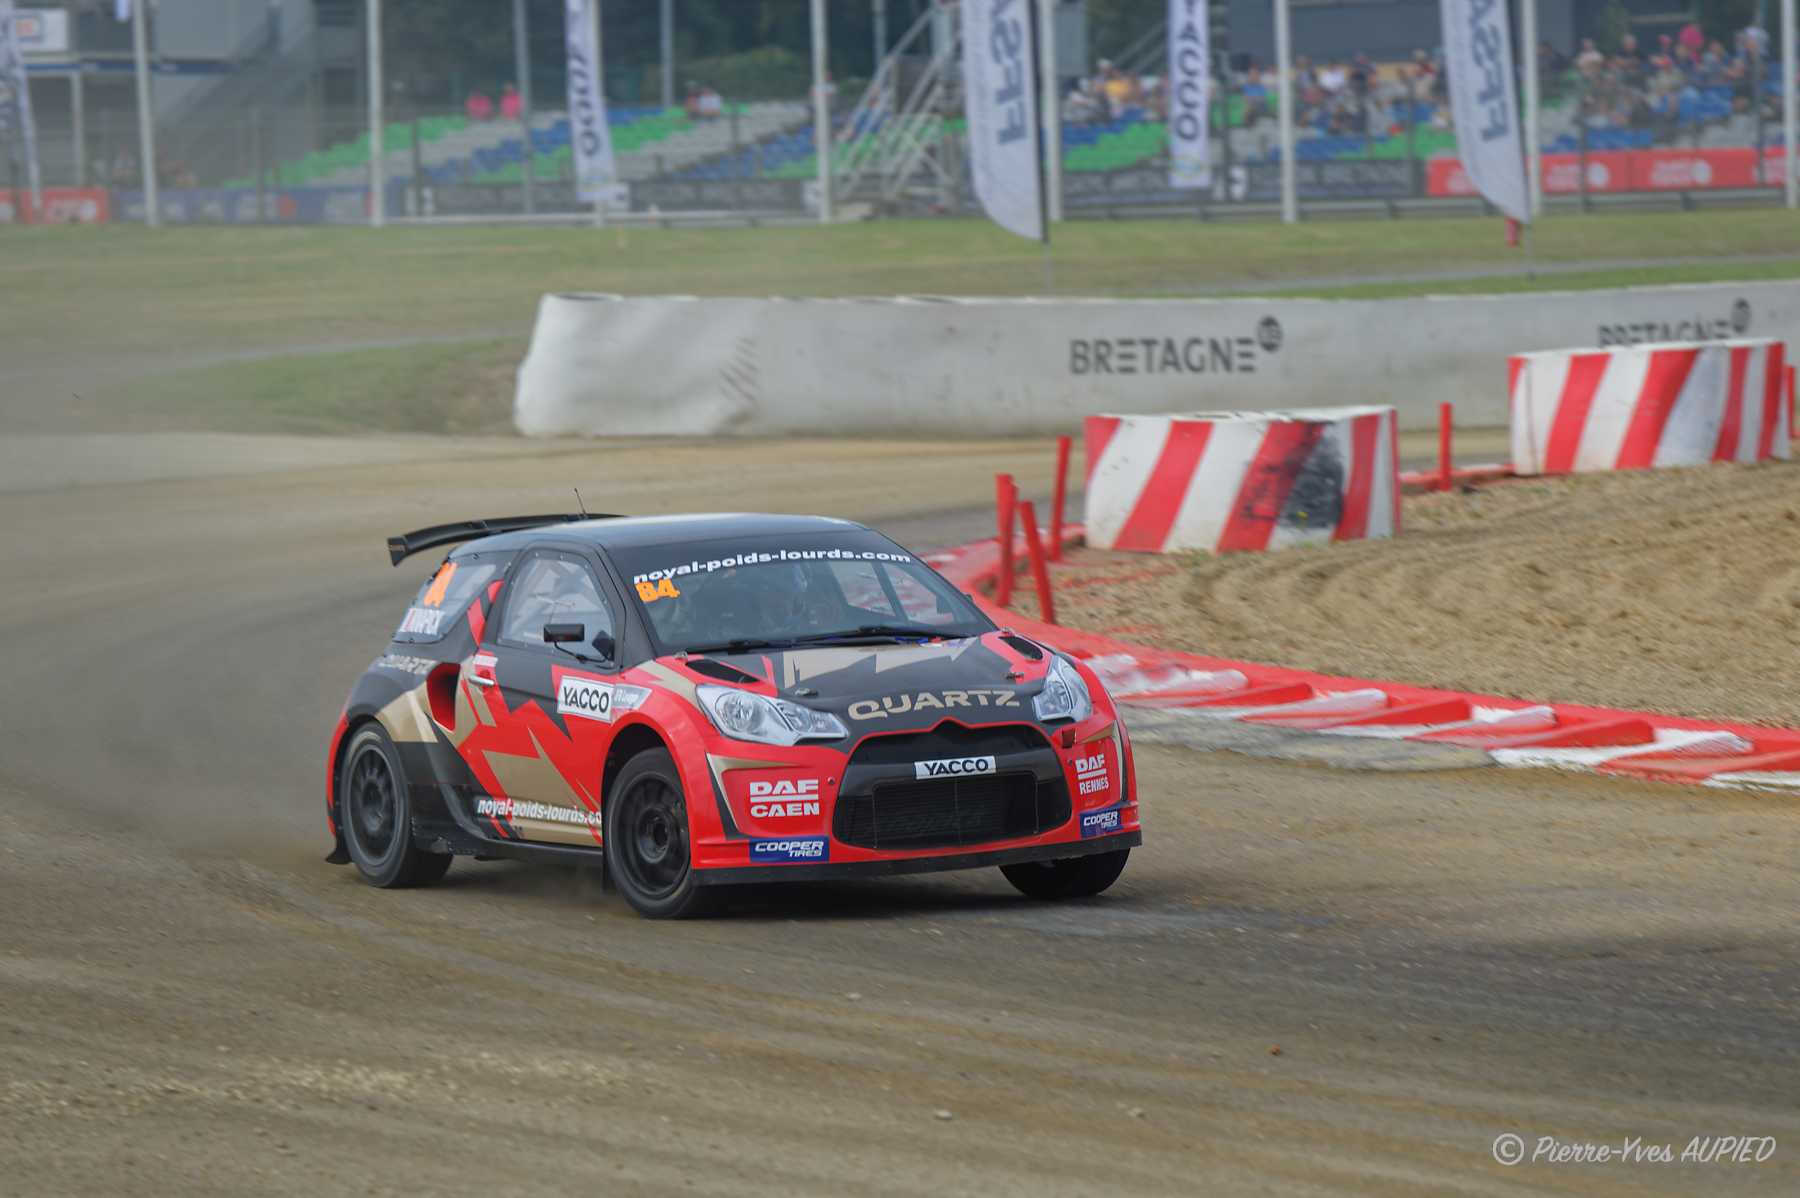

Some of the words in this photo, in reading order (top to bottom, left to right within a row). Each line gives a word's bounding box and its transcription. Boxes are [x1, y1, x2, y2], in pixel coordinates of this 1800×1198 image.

[1069, 336, 1256, 374] BRETAGNE
[633, 549, 912, 585] noyal-poids-lourds.com
[635, 578, 681, 604] 84
[563, 685, 610, 713] YACCO
[847, 690, 1021, 721] QUARTZ
[924, 758, 989, 775] YACCO
[1075, 754, 1105, 773] DAF
[750, 779, 819, 796] DAF
[1079, 776, 1109, 795] RENNES
[750, 802, 820, 818] CAEN
[1083, 811, 1118, 827] COOPER
[755, 841, 824, 852] COOPER
[789, 849, 822, 857] TIRES
